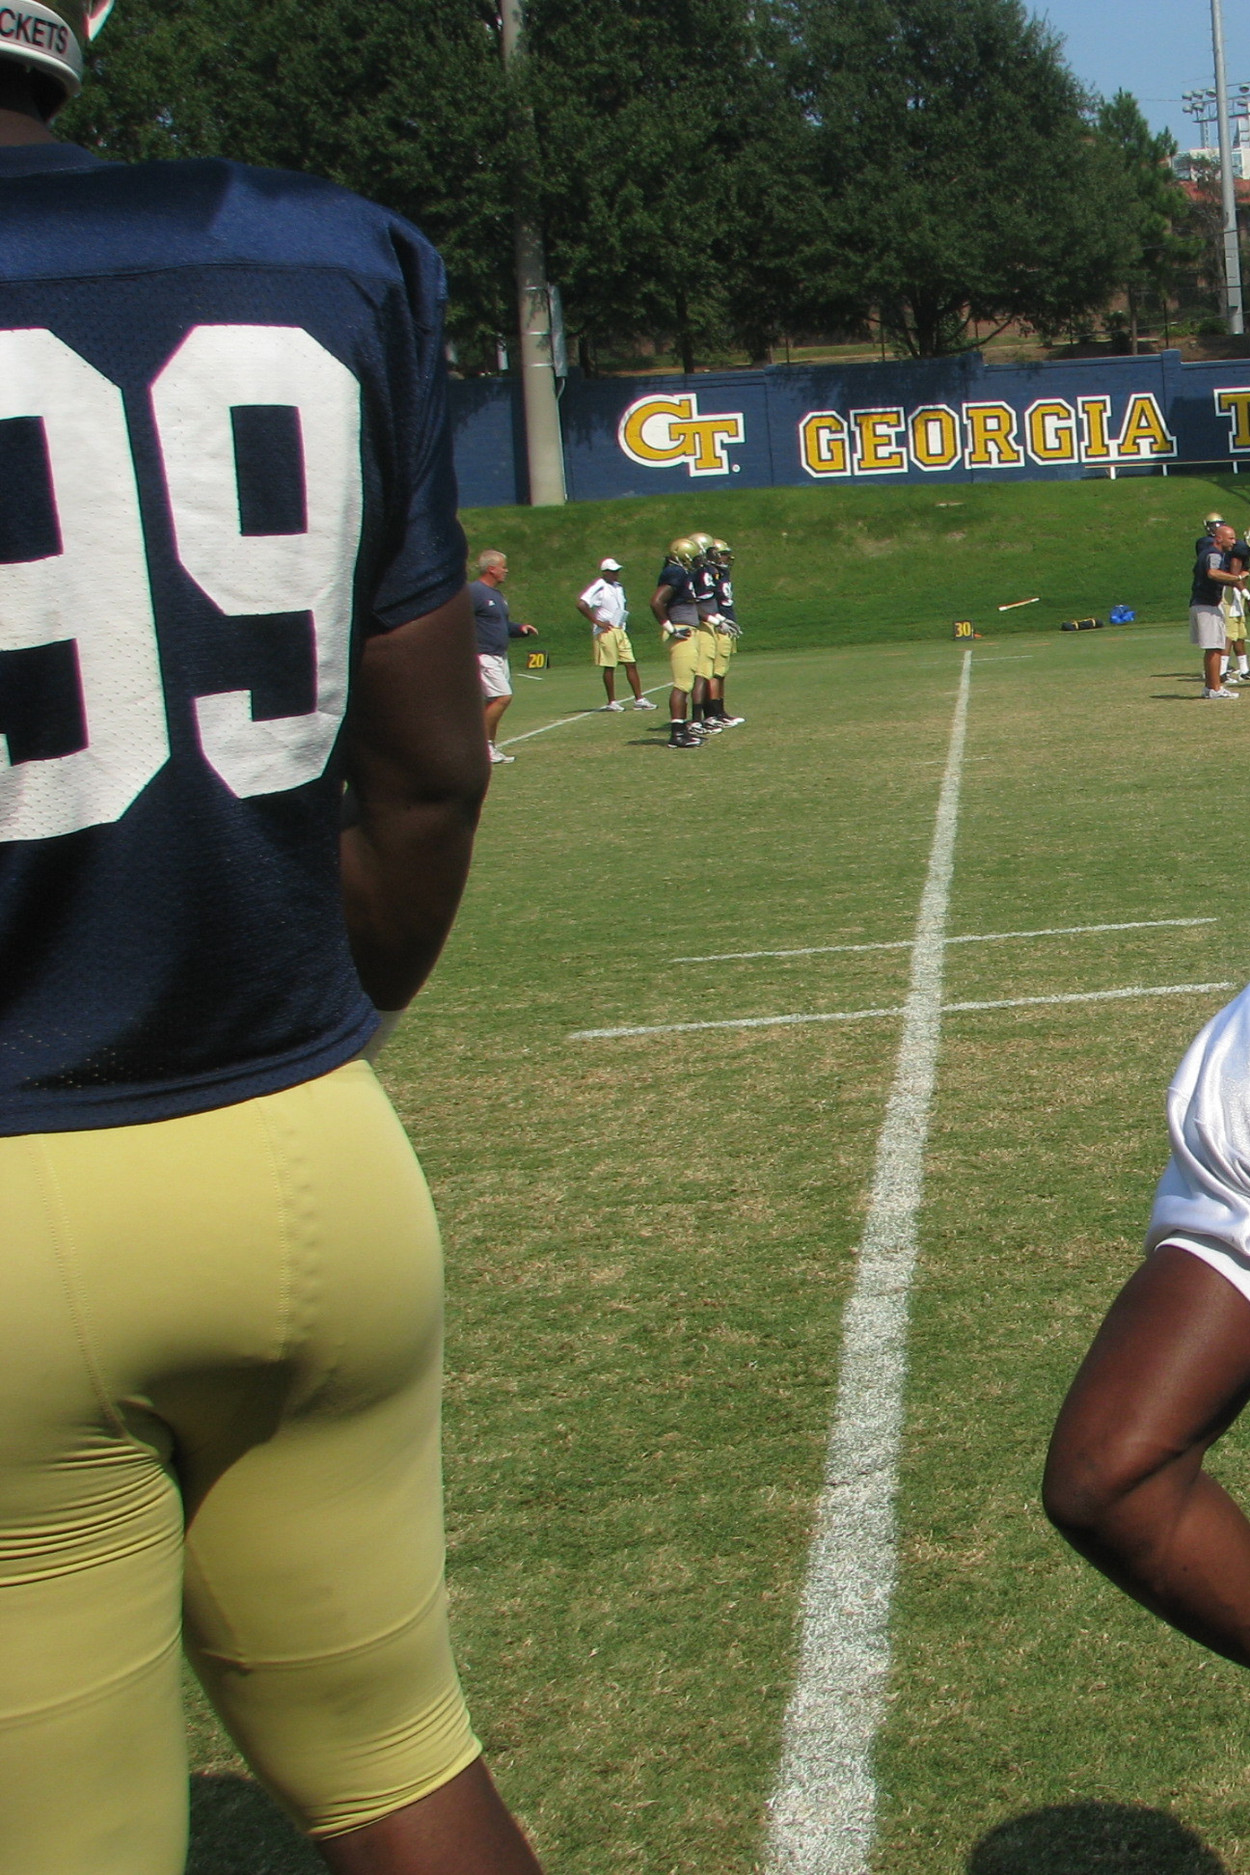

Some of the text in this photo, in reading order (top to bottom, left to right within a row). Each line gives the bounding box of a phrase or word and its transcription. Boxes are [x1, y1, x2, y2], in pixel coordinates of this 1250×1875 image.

[0, 8, 68, 54] CKETS
[618, 392, 744, 477] GT
[799, 393, 1178, 478] GEORGIA
[0, 325, 362, 840] 99
[528, 654, 545, 668] 20
[955, 621, 970, 638] 30
